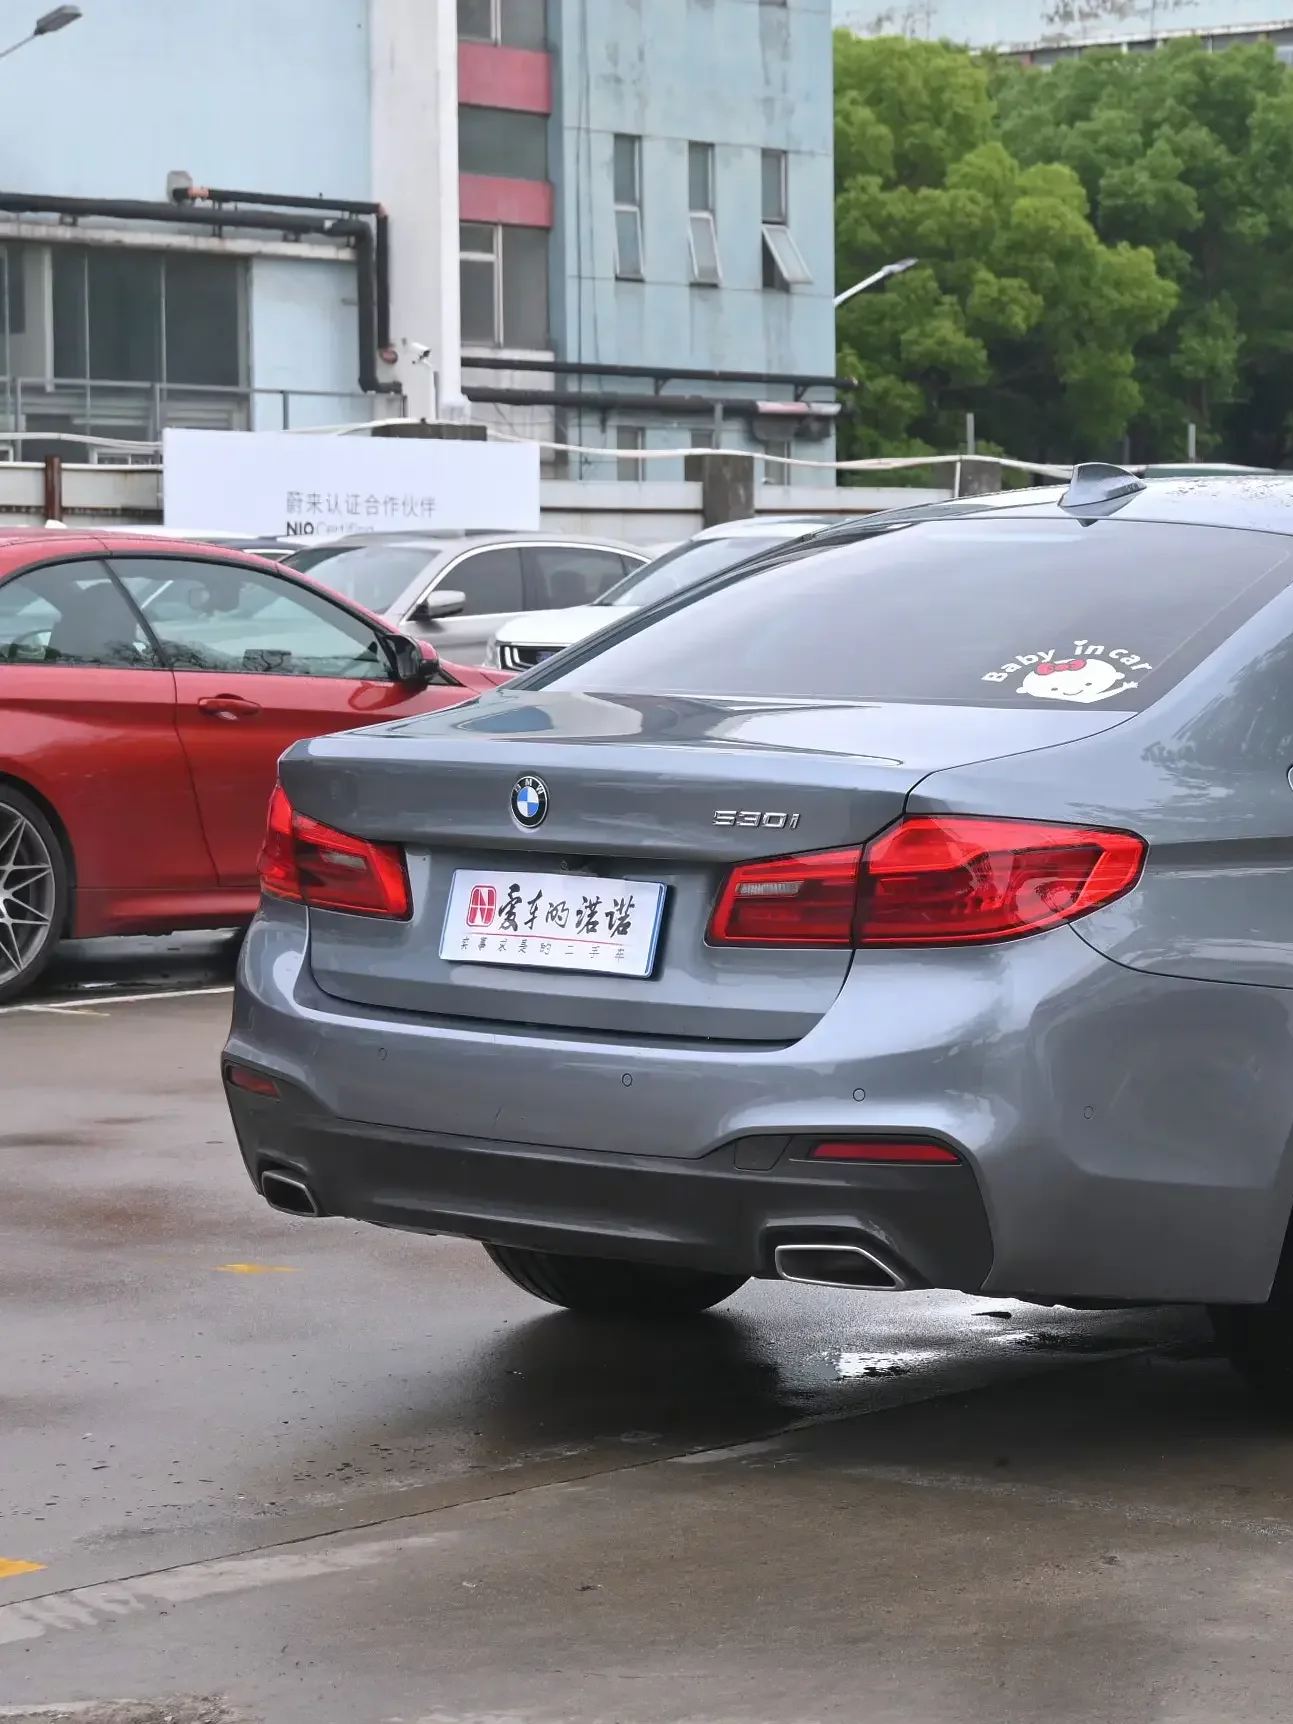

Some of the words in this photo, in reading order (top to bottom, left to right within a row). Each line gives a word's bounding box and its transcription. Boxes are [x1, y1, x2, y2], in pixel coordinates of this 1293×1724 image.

[286, 491, 437, 518] 蔚来认证合作伙伴
[286, 521, 315, 536] NIO
[981, 649, 1056, 683] Baby
[1073, 639, 1105, 656] in
[1108, 648, 1153, 671] car
[712, 809, 801, 829] 530i
